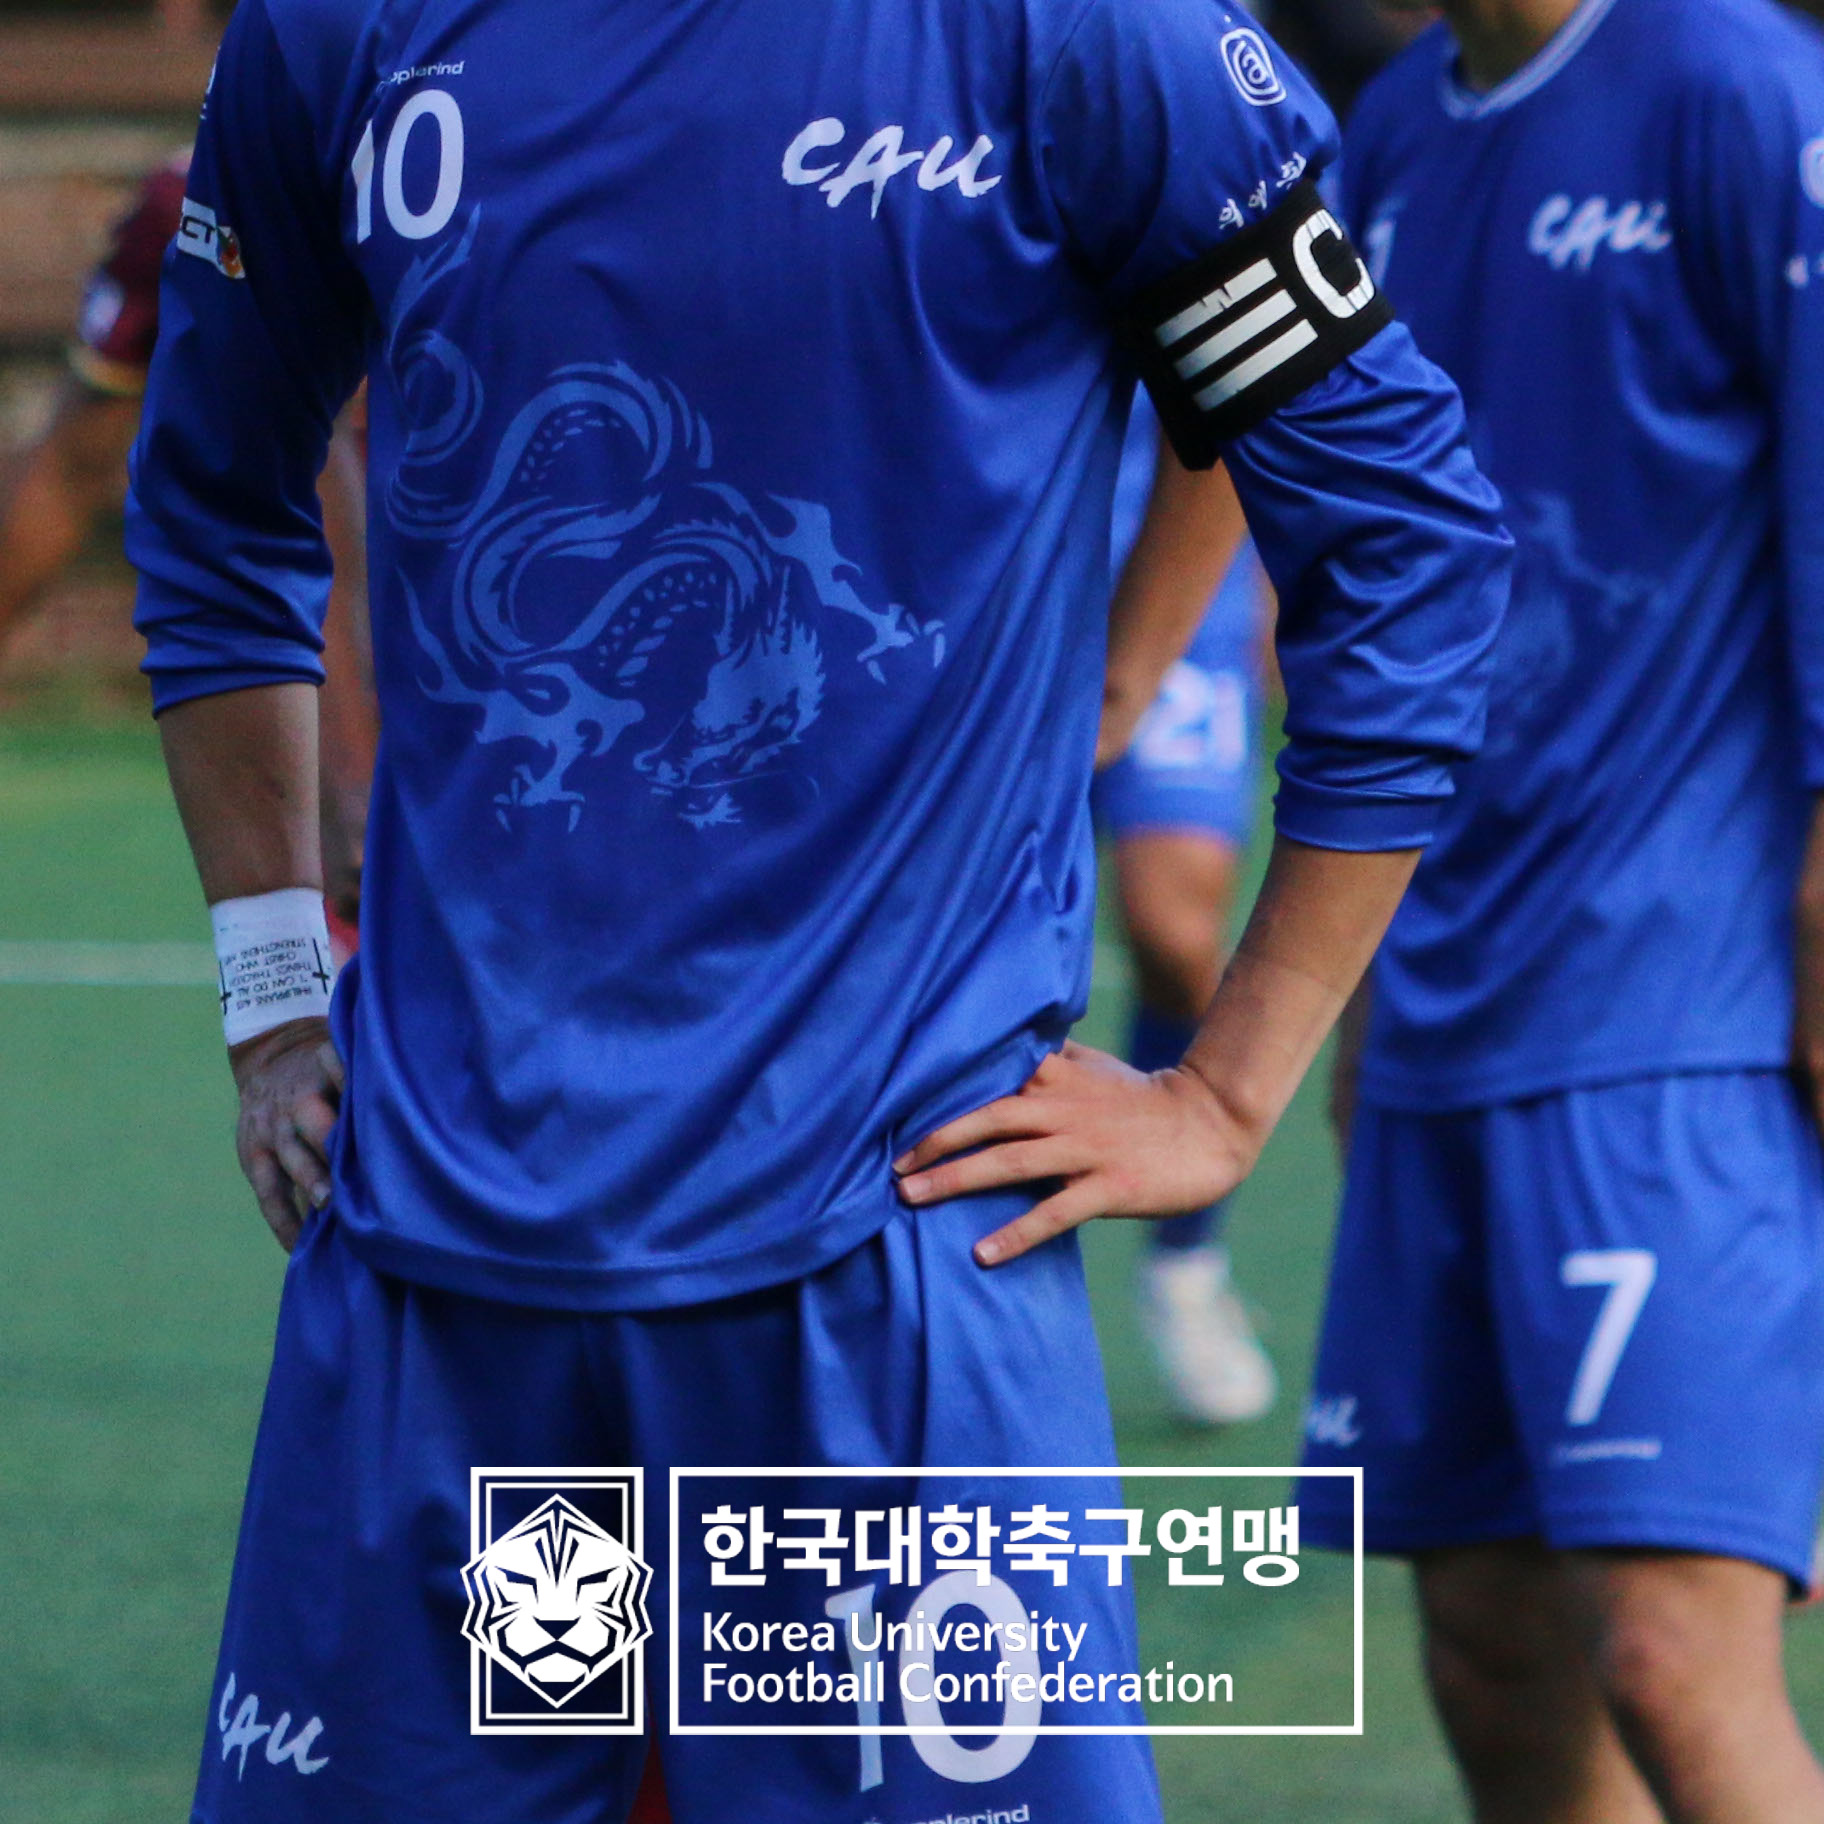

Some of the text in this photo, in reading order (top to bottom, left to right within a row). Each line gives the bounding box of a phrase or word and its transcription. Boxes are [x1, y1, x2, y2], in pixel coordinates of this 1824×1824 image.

[351, 88, 465, 245] 10
[782, 117, 1002, 220] CAU
[1293, 209, 1376, 318] C
[1527, 194, 1674, 272] CAU
[254, 981, 268, 993] DO
[1560, 1248, 1657, 1426] 7
[825, 1570, 1041, 1793] 10
